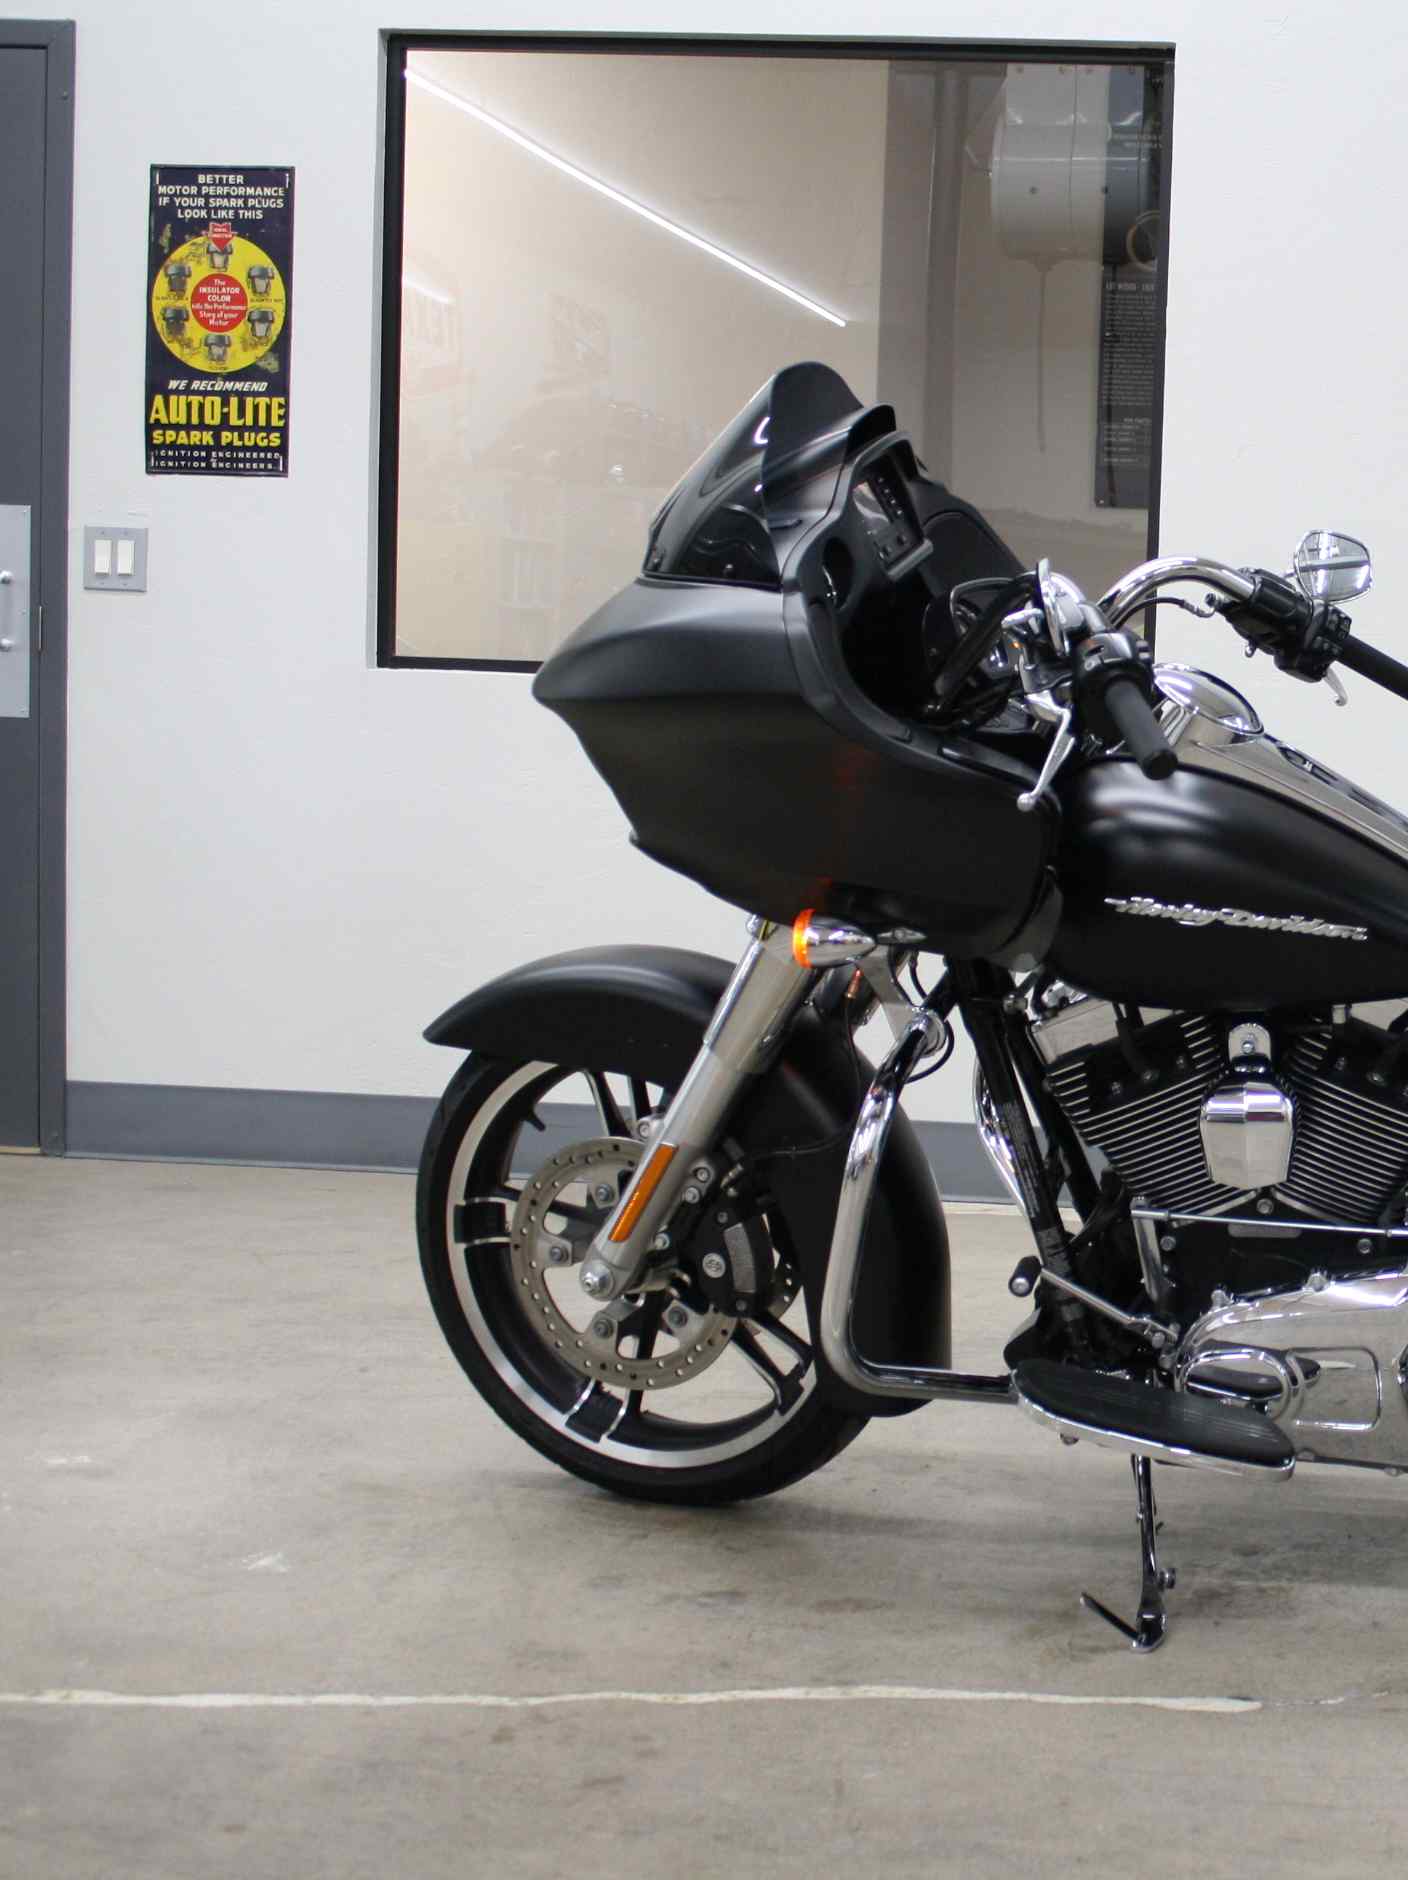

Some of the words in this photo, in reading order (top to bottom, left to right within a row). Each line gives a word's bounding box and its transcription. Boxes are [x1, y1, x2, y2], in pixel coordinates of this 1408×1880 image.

[198, 174, 244, 184] BETTER
[158, 185, 198, 195] MOTOR
[202, 186, 285, 197] PERFORMANCE
[158, 197, 170, 206] IF
[174, 197, 205, 207] YOUR
[208, 198, 244, 208] SPARK
[248, 199, 284, 208] PLUGS
[178, 210, 208, 218] LOOK
[211, 210, 234, 219] LIKE
[239, 210, 264, 219] THIS
[207, 294, 231, 302] COLOR
[168, 380, 188, 390] WE
[190, 380, 268, 392] RECOMMEND
[150, 395, 286, 427] AUTO-LITE
[152, 430, 215, 446] SPARK
[221, 431, 281, 447] PLUGS
[212, 451, 280, 459] ENGINEERED
[155, 460, 206, 468] IGNITION
